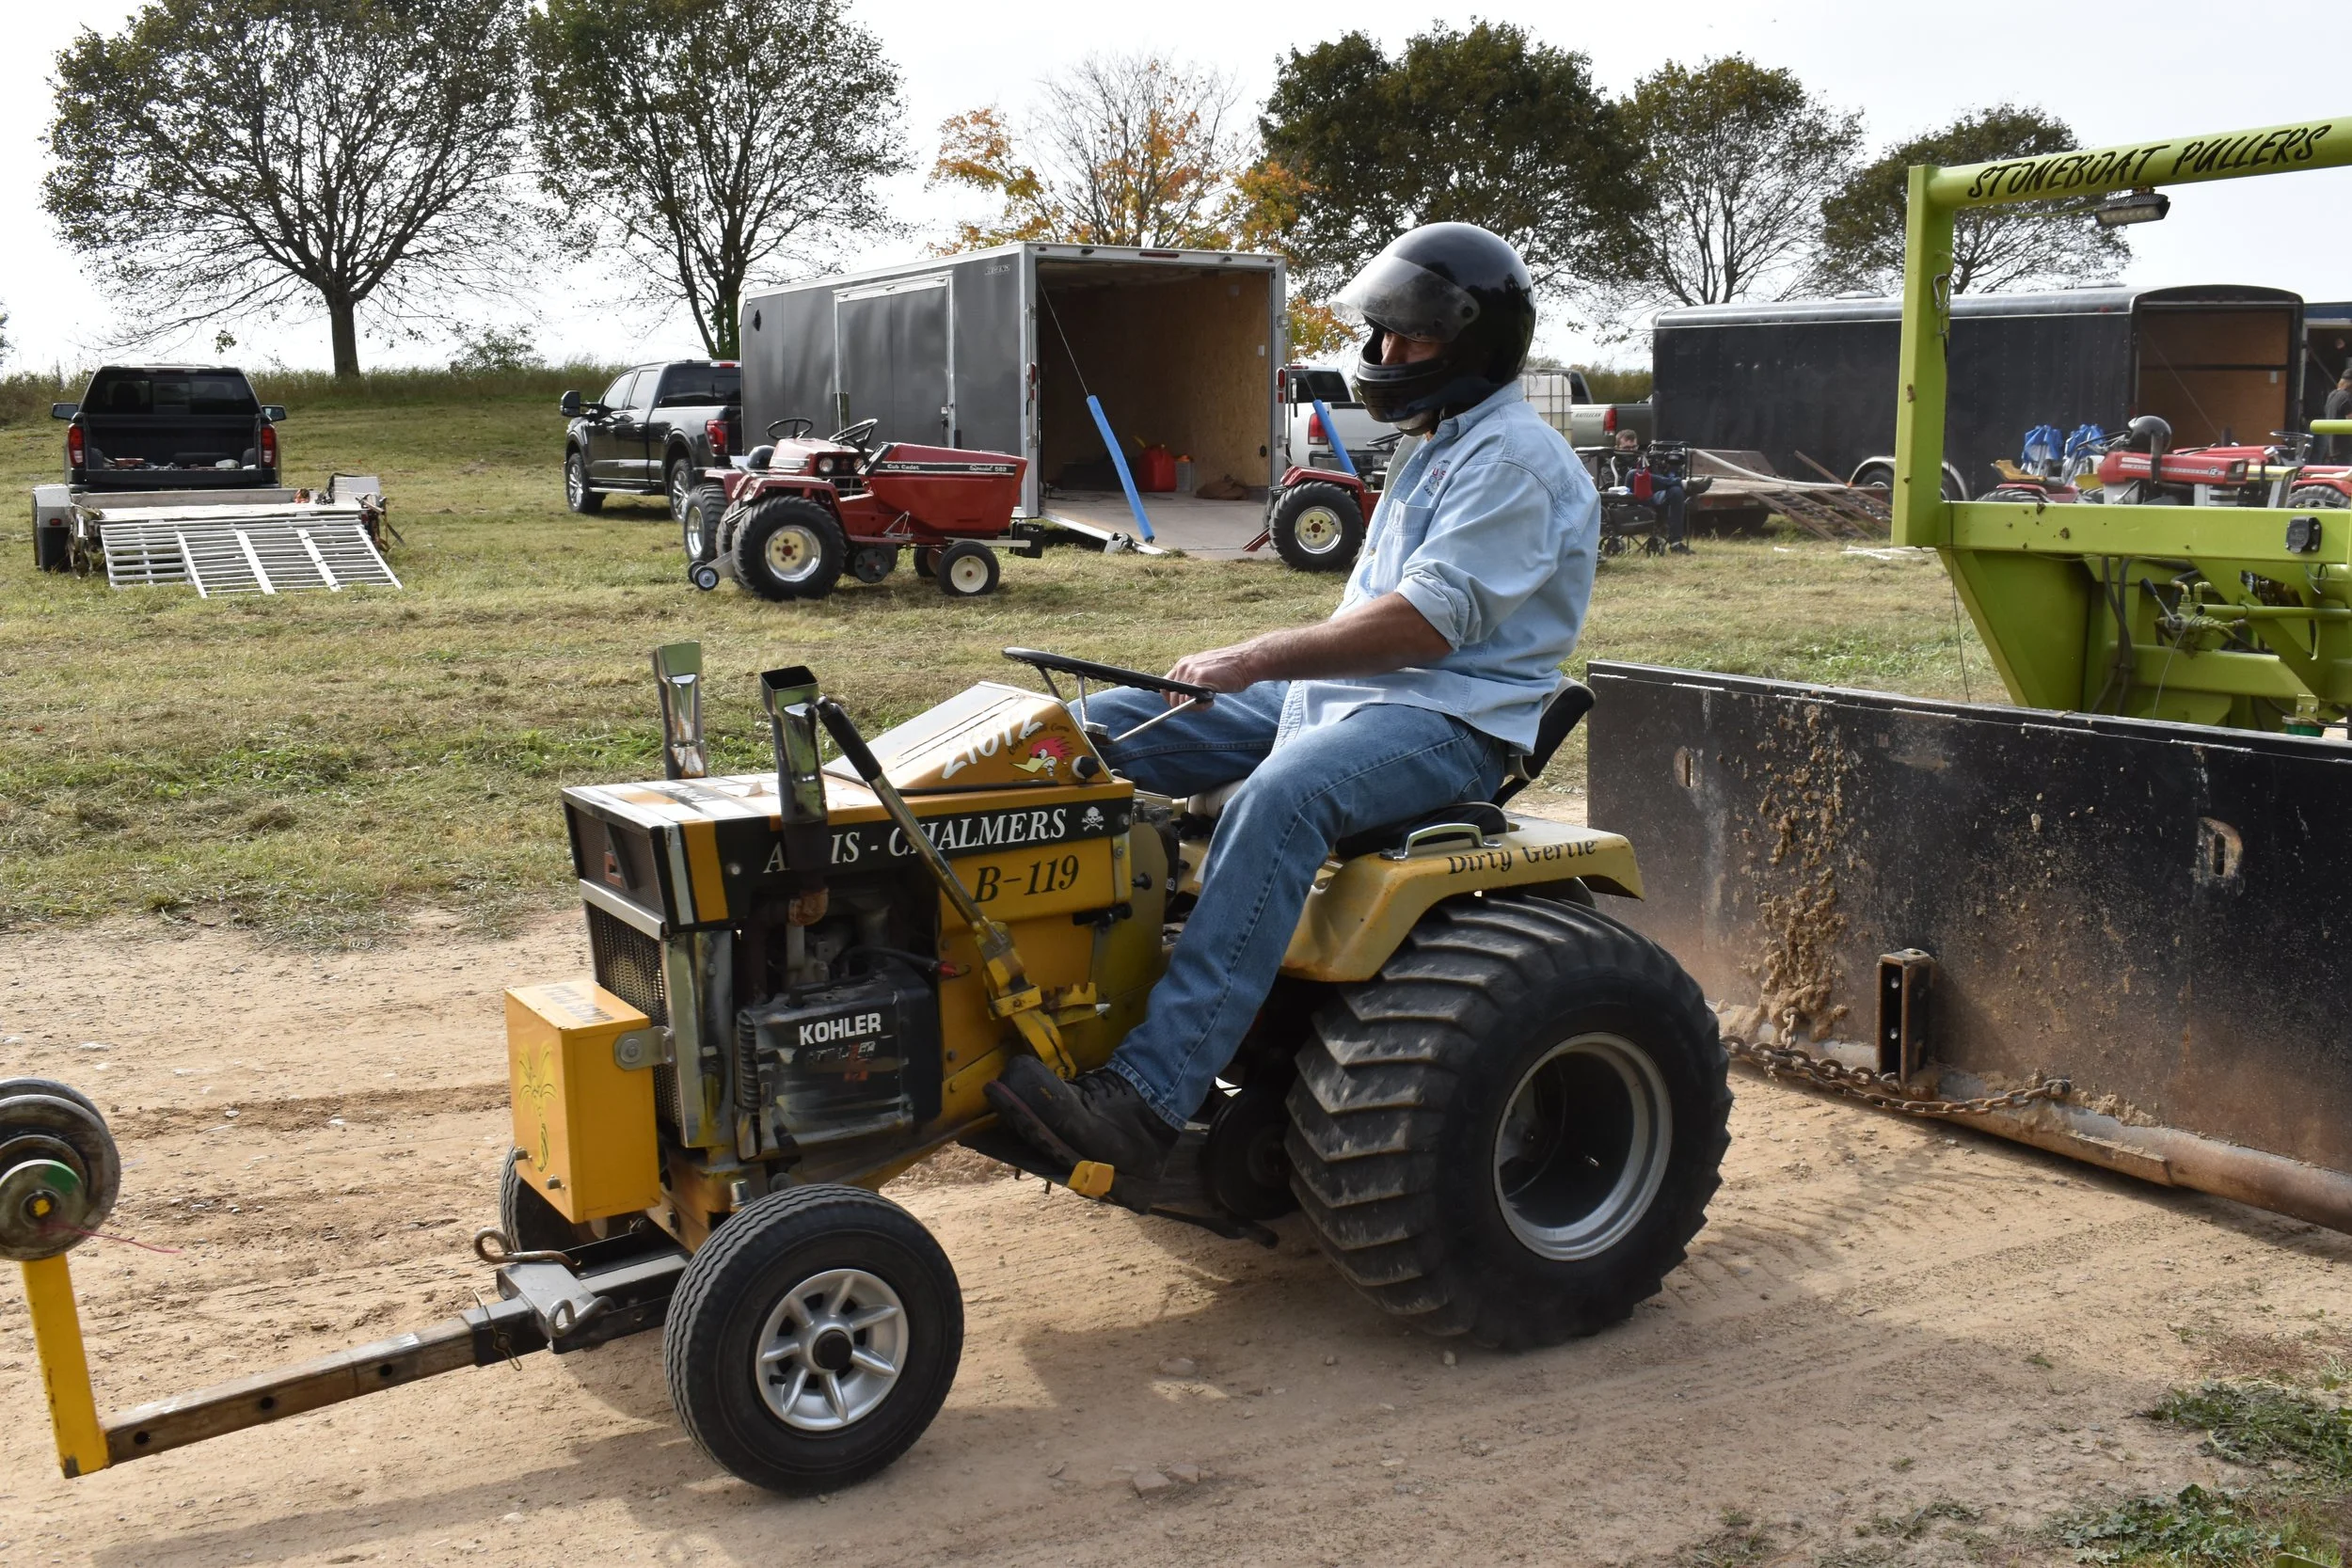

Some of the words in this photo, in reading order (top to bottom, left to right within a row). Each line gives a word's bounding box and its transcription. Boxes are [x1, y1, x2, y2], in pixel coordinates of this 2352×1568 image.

[1967, 145, 2171, 198] STONEBOAT
[2170, 124, 2332, 177] PULLERS
[762, 832, 861, 874] AIS
[1447, 850, 1513, 875] Dirty
[973, 854, 1080, 904] B-119
[799, 1012, 882, 1046] KOHLER
